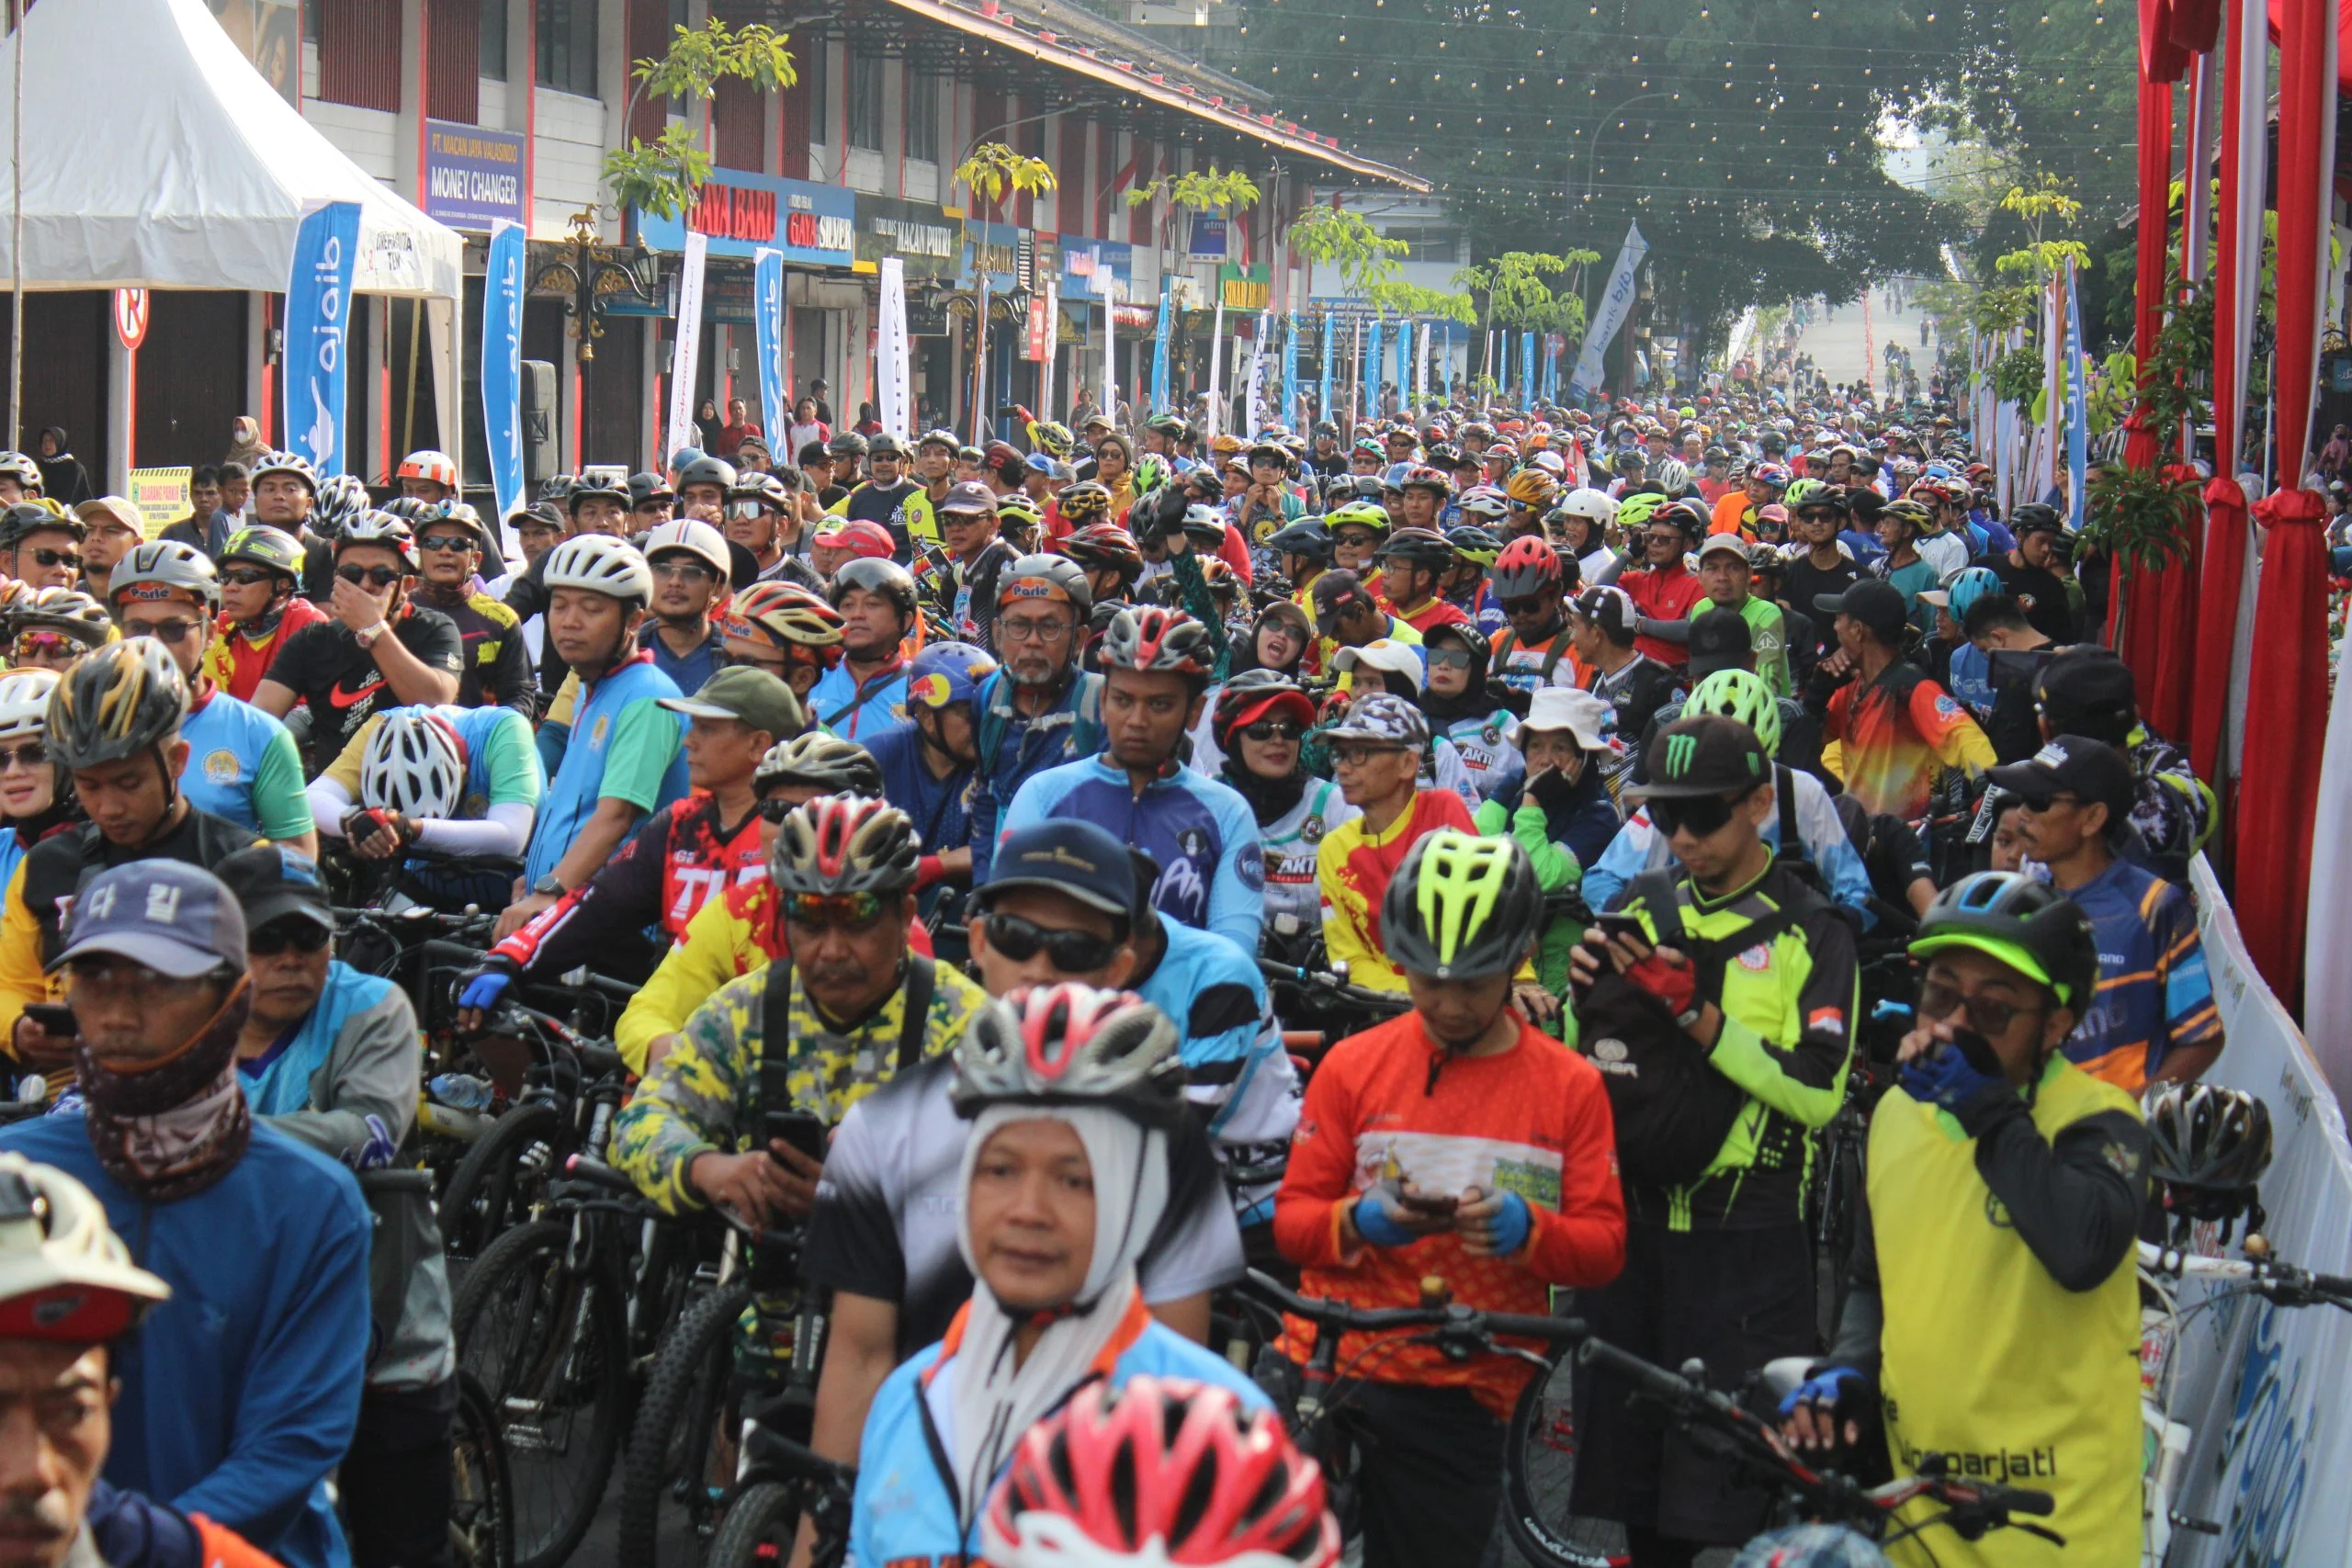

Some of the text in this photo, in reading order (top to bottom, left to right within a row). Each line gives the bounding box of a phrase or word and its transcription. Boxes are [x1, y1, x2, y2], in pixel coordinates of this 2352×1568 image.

[431, 166, 516, 205] MONEY CHANGER
[684, 183, 776, 243] AYA BARU
[790, 212, 852, 251] GAYA SILVER
[1204, 220, 1225, 229] atm
[897, 222, 925, 254] MACAN
[926, 225, 951, 258] PUTRI
[312, 236, 342, 373] ajaib
[1225, 278, 1247, 309] SINAR
[764, 277, 780, 377] ajaib
[1594, 307, 1617, 353] bank
[130, 588, 170, 599] Parle
[1012, 584, 1050, 597] Parle
